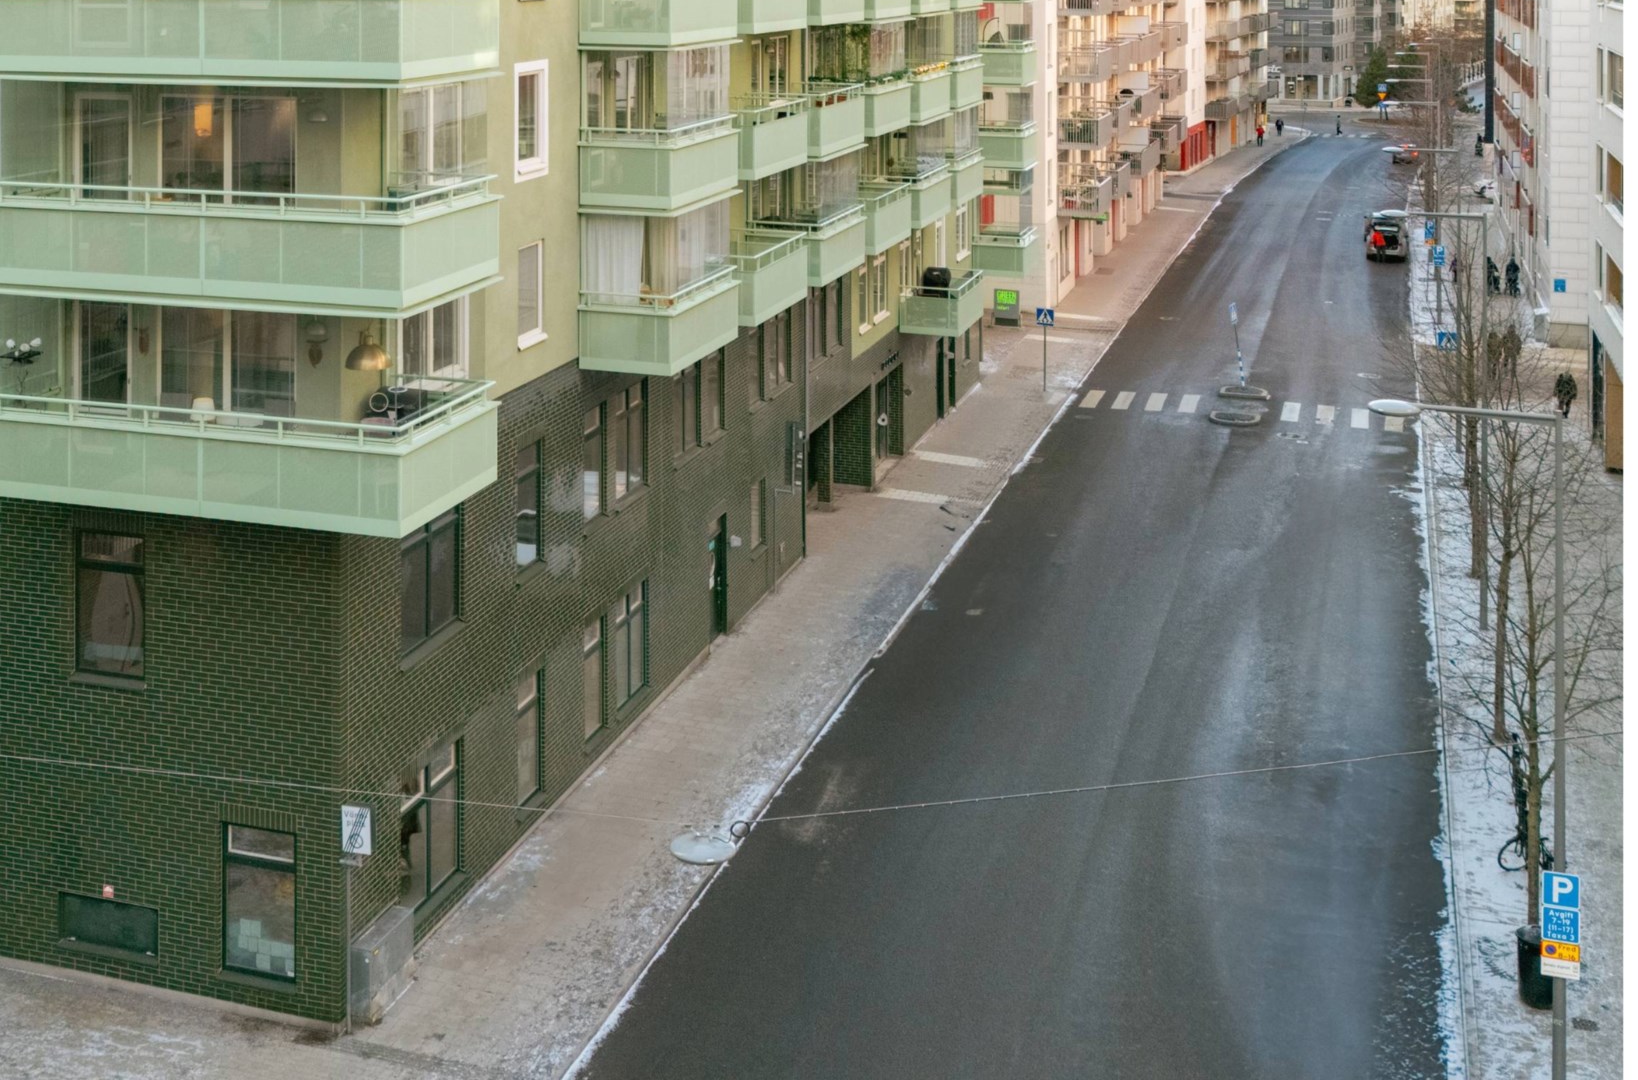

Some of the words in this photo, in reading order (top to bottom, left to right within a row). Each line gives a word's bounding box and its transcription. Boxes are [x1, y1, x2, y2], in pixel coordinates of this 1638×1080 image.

[1552, 875, 1573, 903] P
[1548, 909, 1574, 919] Avgift
[1548, 923, 1574, 934] (11-17)
[1547, 930, 1567, 940] Taxa
